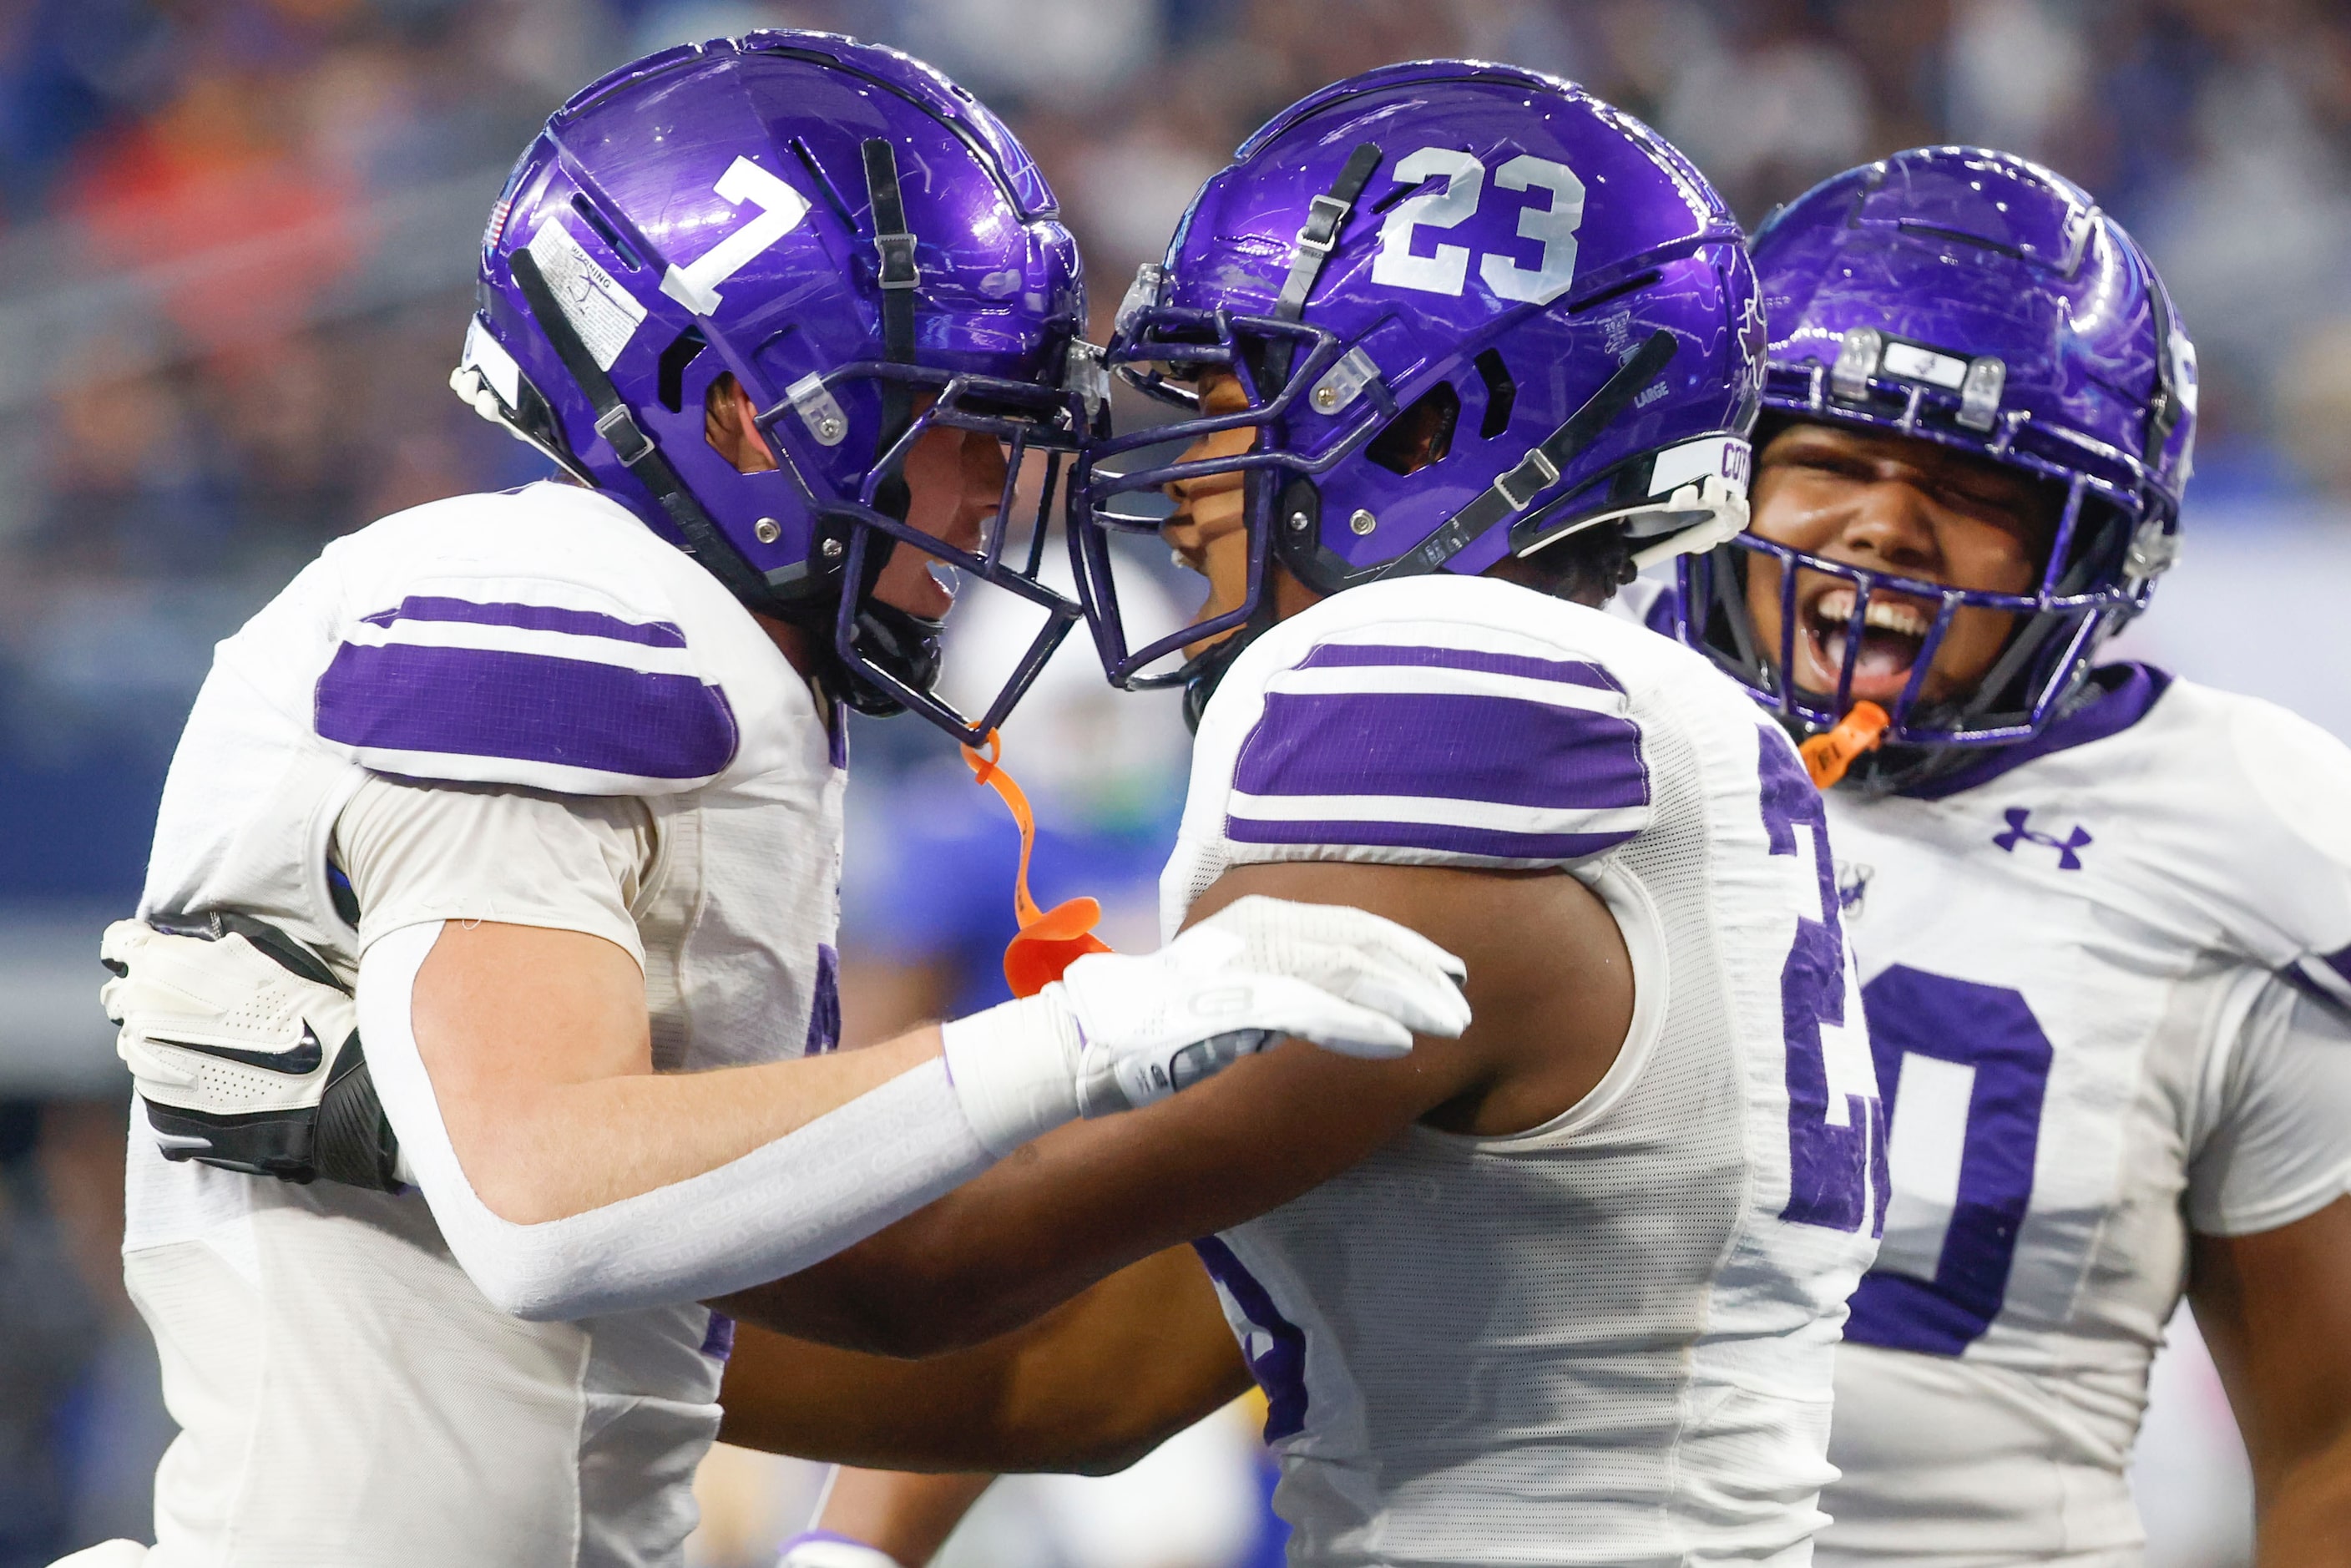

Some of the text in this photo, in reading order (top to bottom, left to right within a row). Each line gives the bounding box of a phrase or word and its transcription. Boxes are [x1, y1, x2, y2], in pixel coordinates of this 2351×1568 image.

[659, 154, 811, 316] 7
[1371, 146, 1585, 306] 23
[1634, 381, 1669, 409] LARGE
[1842, 963, 2054, 1357] 0
